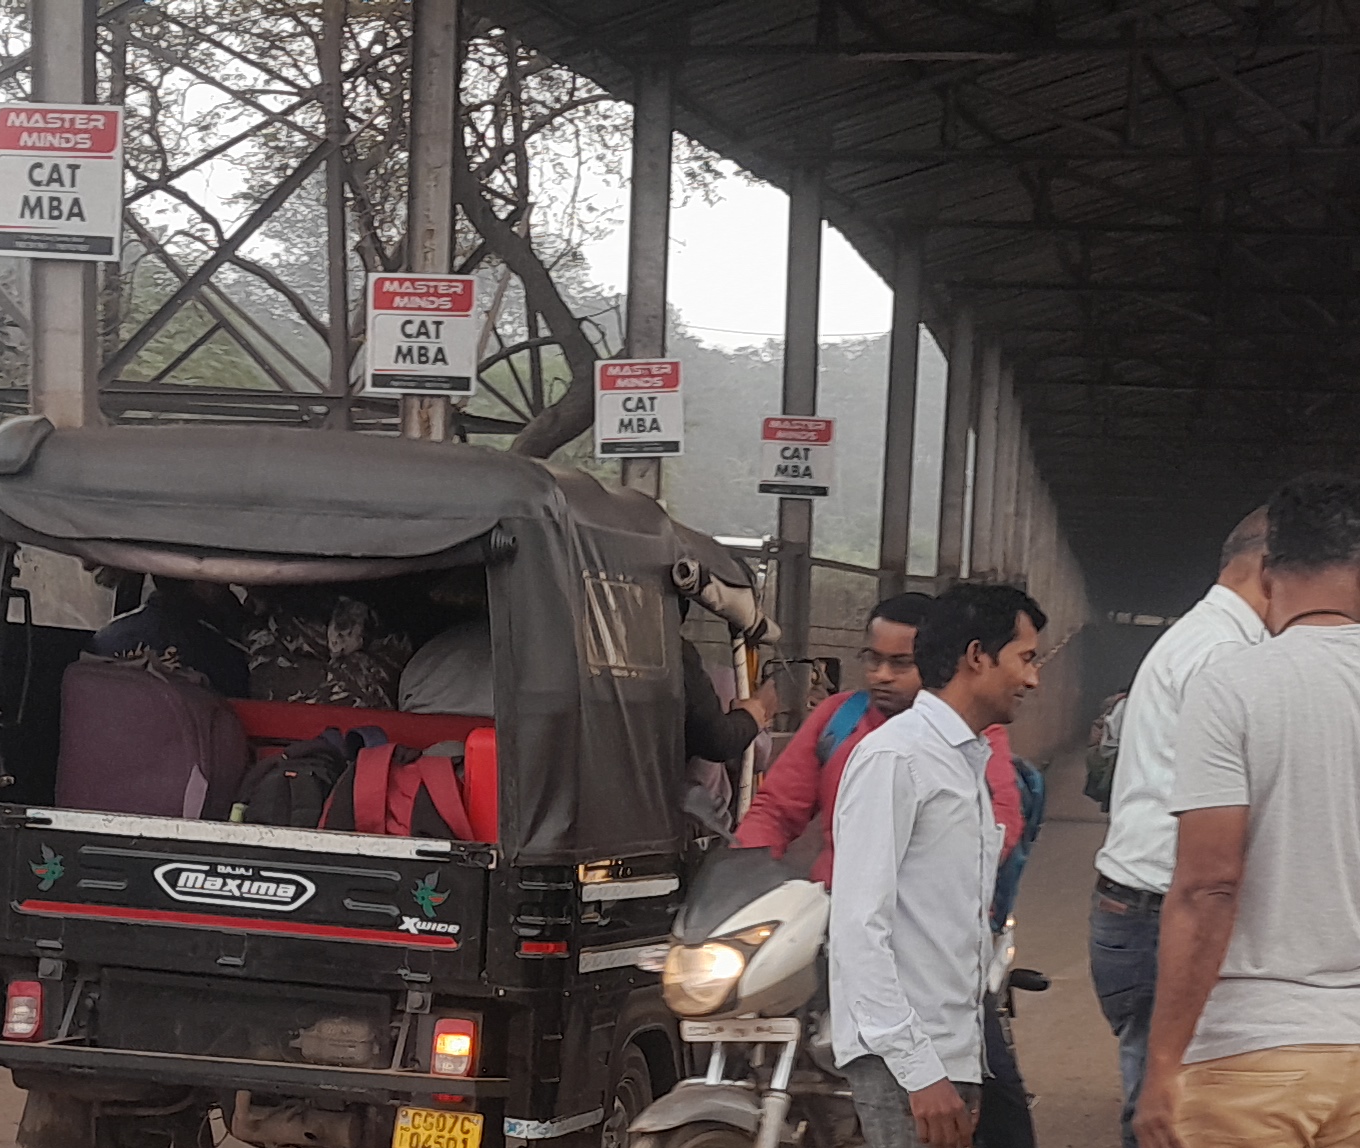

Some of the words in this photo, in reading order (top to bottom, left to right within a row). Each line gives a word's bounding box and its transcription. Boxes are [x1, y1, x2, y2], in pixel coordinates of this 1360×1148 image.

[6, 111, 106, 130] MASTER
[19, 131, 93, 149] MINDS
[28, 162, 81, 189] CAT
[19, 195, 86, 222] MBA
[382, 280, 464, 295] MASTER
[392, 295, 453, 309] MINDS
[400, 319, 445, 340] CAT
[394, 345, 449, 366] MBA
[622, 396, 658, 413] CAT
[617, 417, 662, 434] MBA
[780, 446, 811, 461] CAT
[774, 464, 813, 479] MBA
[217, 864, 253, 876] BAJAJ
